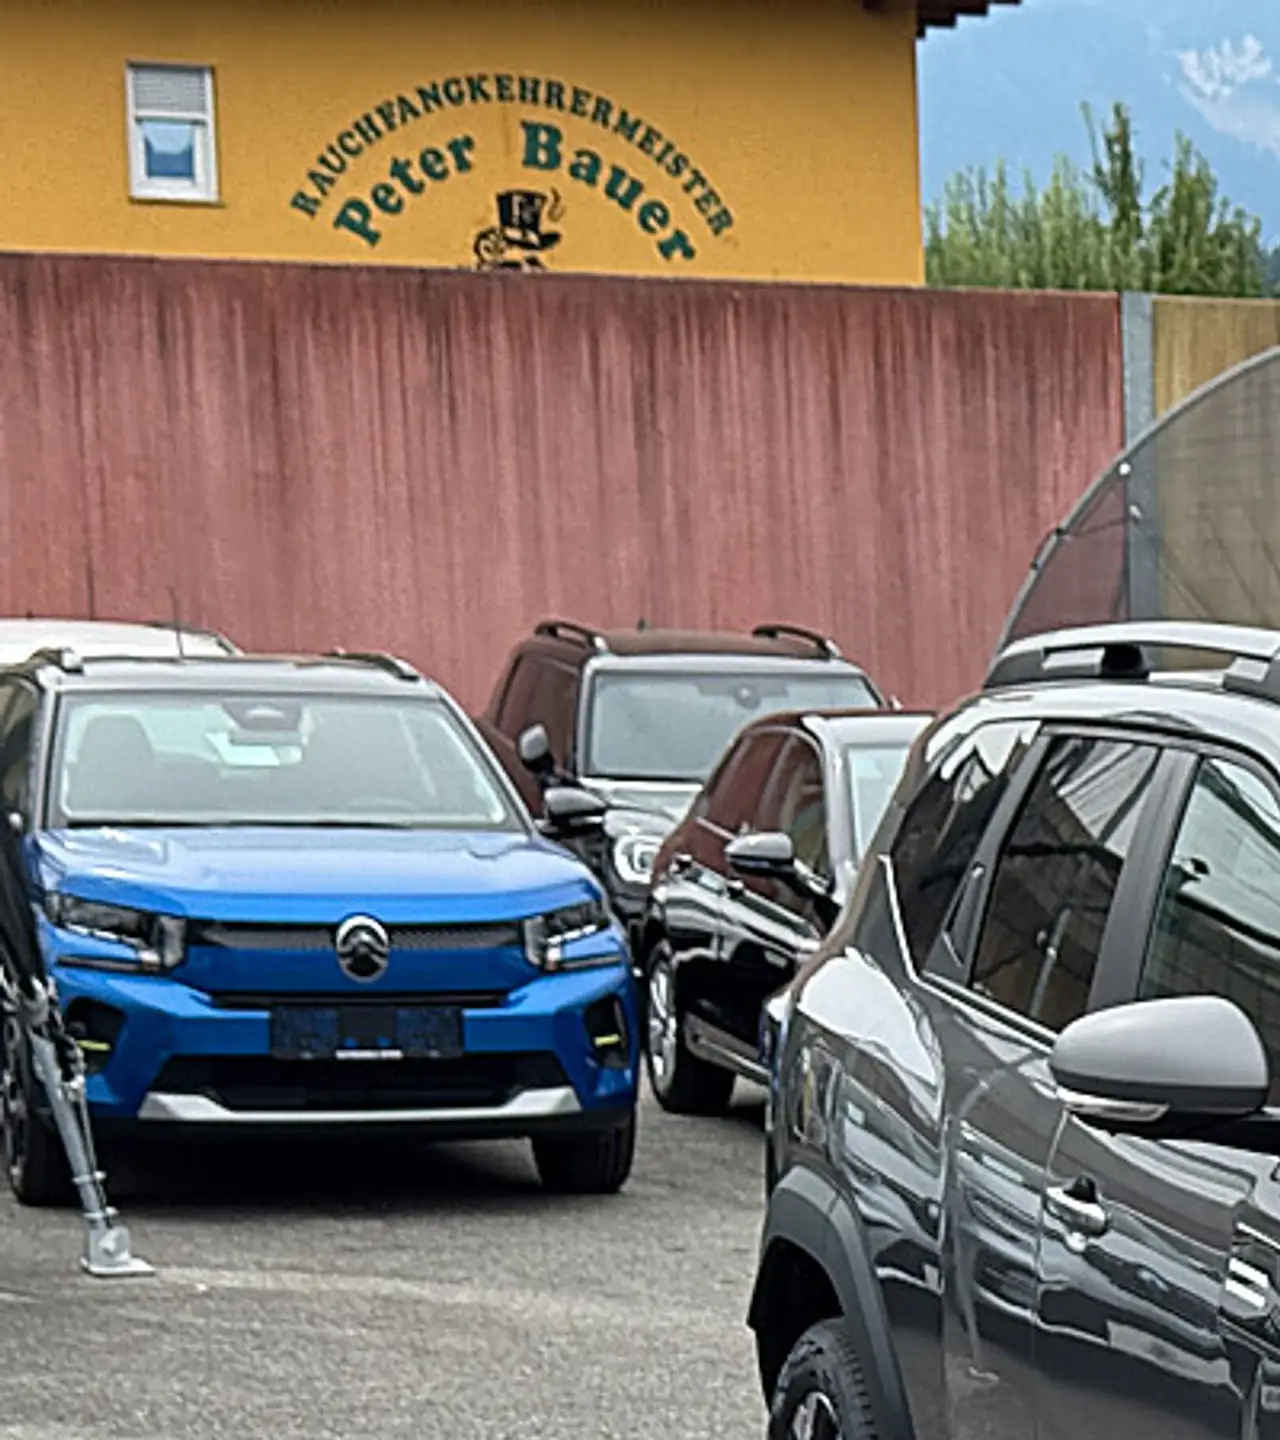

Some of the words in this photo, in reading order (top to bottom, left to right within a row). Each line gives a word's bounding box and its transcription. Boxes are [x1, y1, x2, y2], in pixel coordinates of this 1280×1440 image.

[290, 73, 734, 236] RAUCHFANGKEHRERMEISTER
[333, 134, 476, 249] Peter
[520, 120, 696, 261] Bauer
